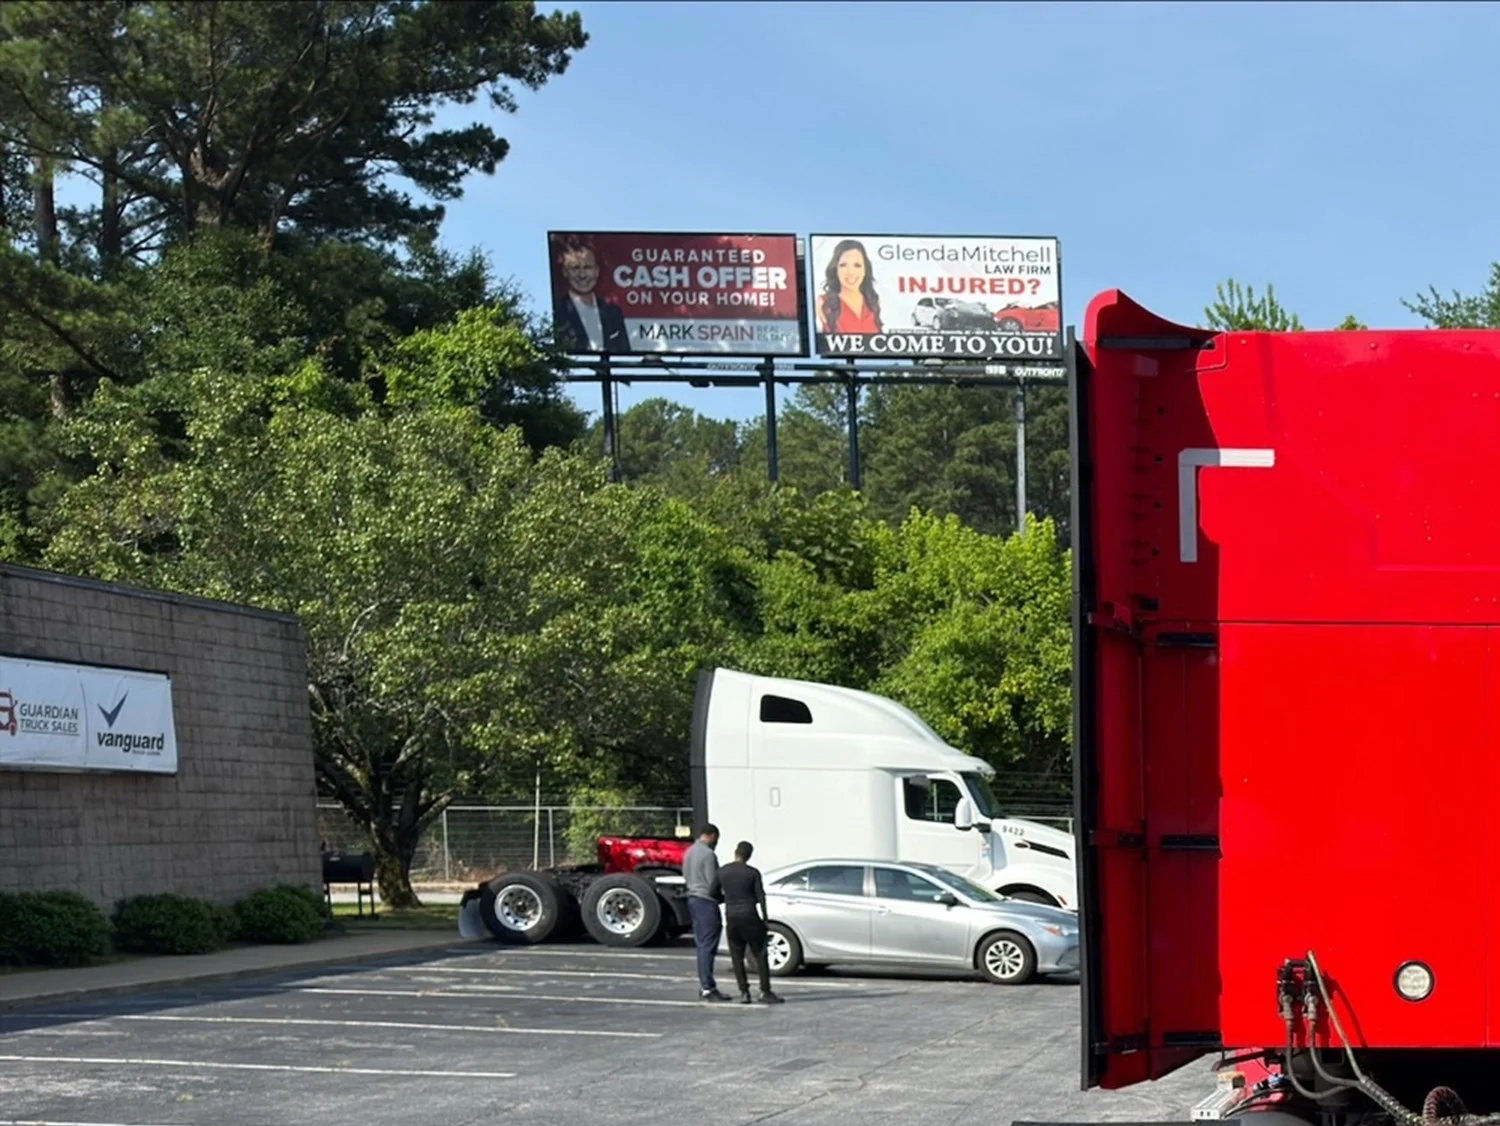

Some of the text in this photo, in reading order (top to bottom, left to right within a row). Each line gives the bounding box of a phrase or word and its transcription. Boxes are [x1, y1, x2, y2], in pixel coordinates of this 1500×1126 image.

[631, 248, 766, 264] GUARANTEED
[613, 265, 788, 290] CASH OFFER
[984, 265, 1052, 276] LAW FIRM
[897, 276, 1042, 296] INJURED?
[626, 290, 776, 307] ON YOUR HOME!
[639, 324, 694, 341] MARK
[697, 325, 755, 342] SPAIN
[826, 335, 1054, 356] WE COME TO YOU!
[20, 703, 79, 720] GUARDIAN
[20, 718, 79, 733] TRUCK SALES
[97, 731, 165, 753] vanguard
